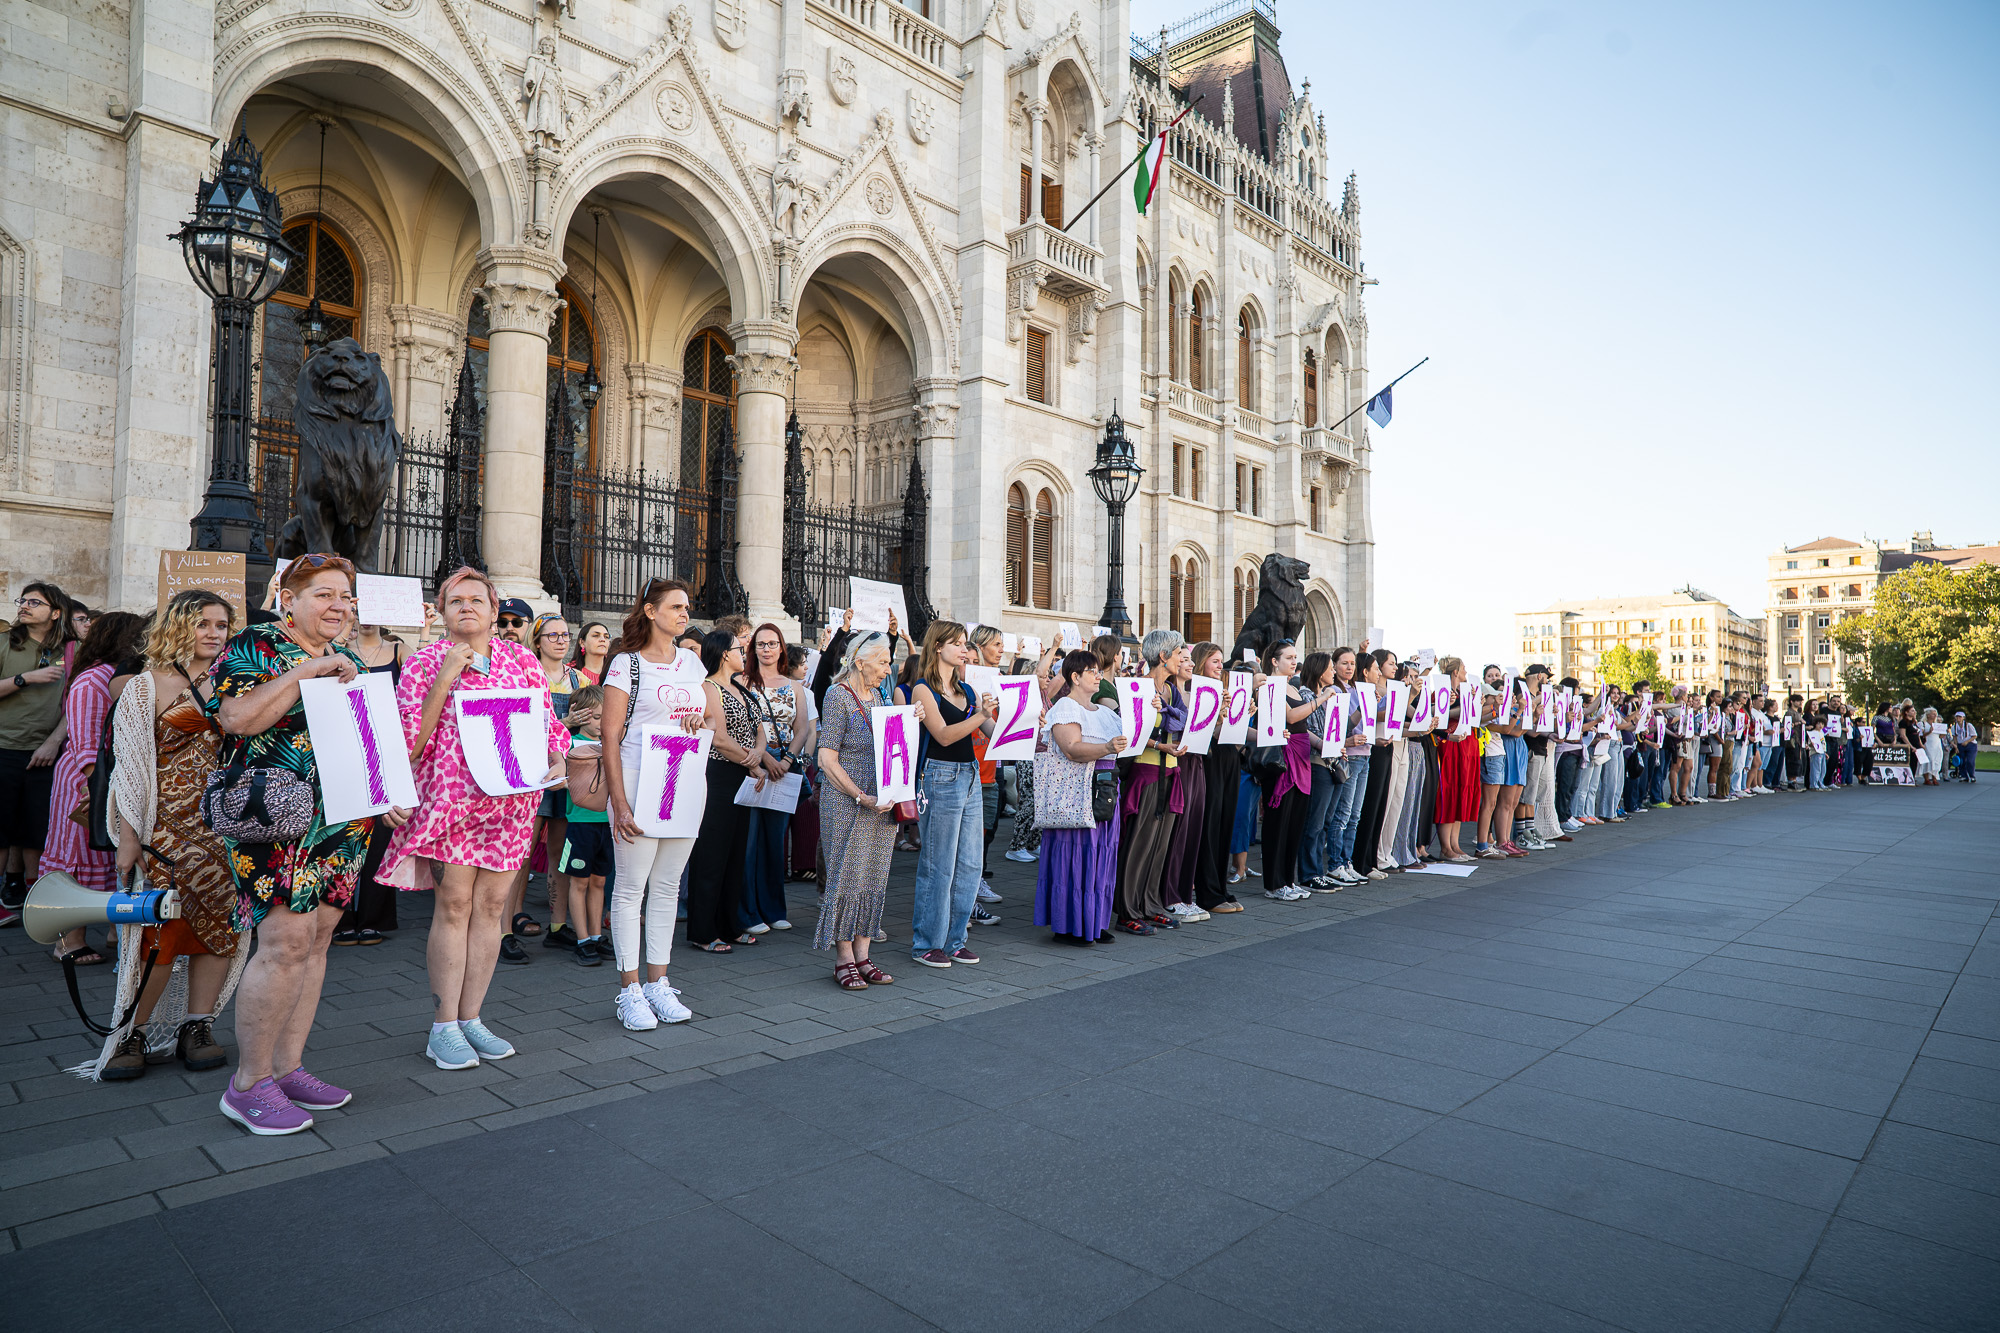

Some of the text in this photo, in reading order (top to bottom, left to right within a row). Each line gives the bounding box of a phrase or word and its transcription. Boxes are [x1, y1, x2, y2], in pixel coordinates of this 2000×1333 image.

[177, 554, 210, 570] WILL
[216, 555, 240, 566] NOT
[992, 681, 1035, 750] Z
[1188, 686, 1220, 734] D
[1361, 691, 1375, 727] L
[1387, 690, 1402, 730] L
[461, 697, 532, 789] T
[881, 713, 910, 788] A
[650, 734, 701, 821] T
